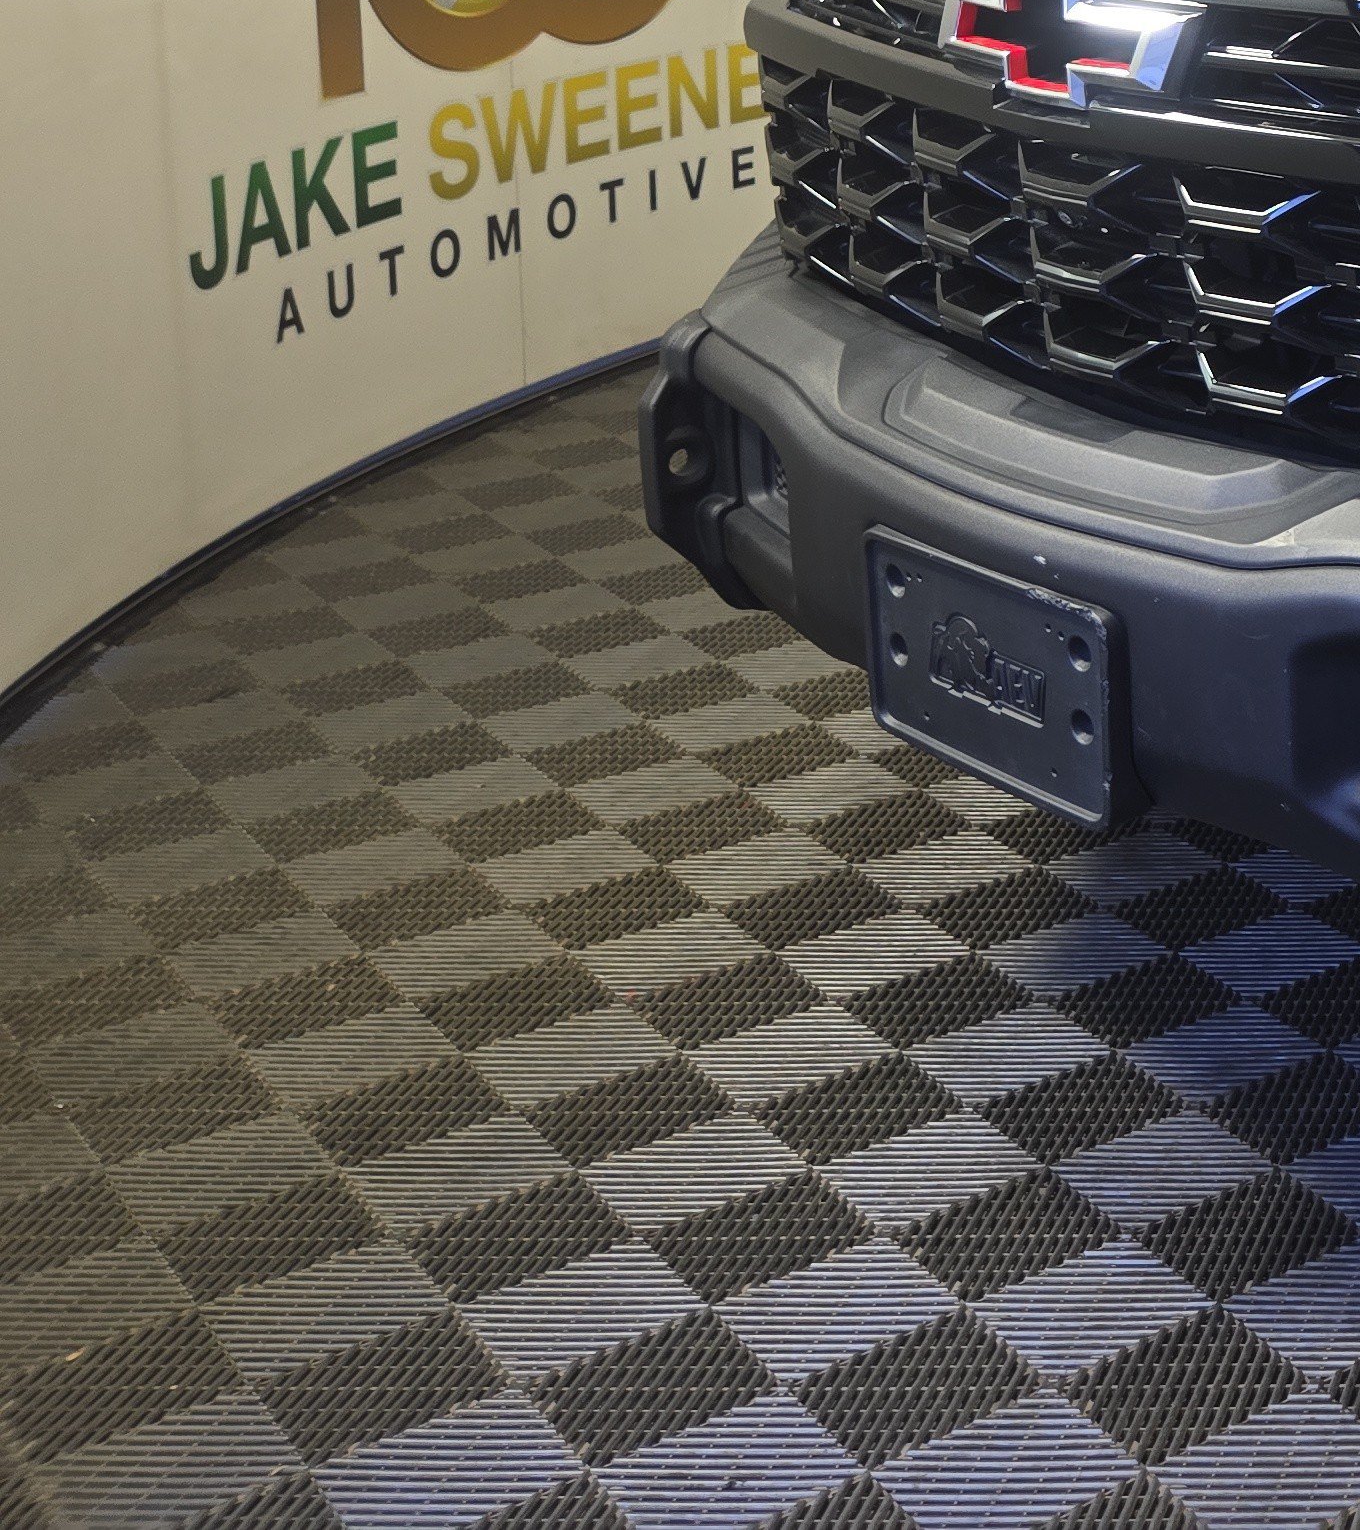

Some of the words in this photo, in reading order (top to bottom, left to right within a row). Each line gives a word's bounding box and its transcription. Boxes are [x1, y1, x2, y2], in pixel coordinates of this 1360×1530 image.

[187, 121, 404, 291] JAKE
[427, 43, 768, 201] SWEENE
[275, 145, 757, 344] AUTOMOTIVE
